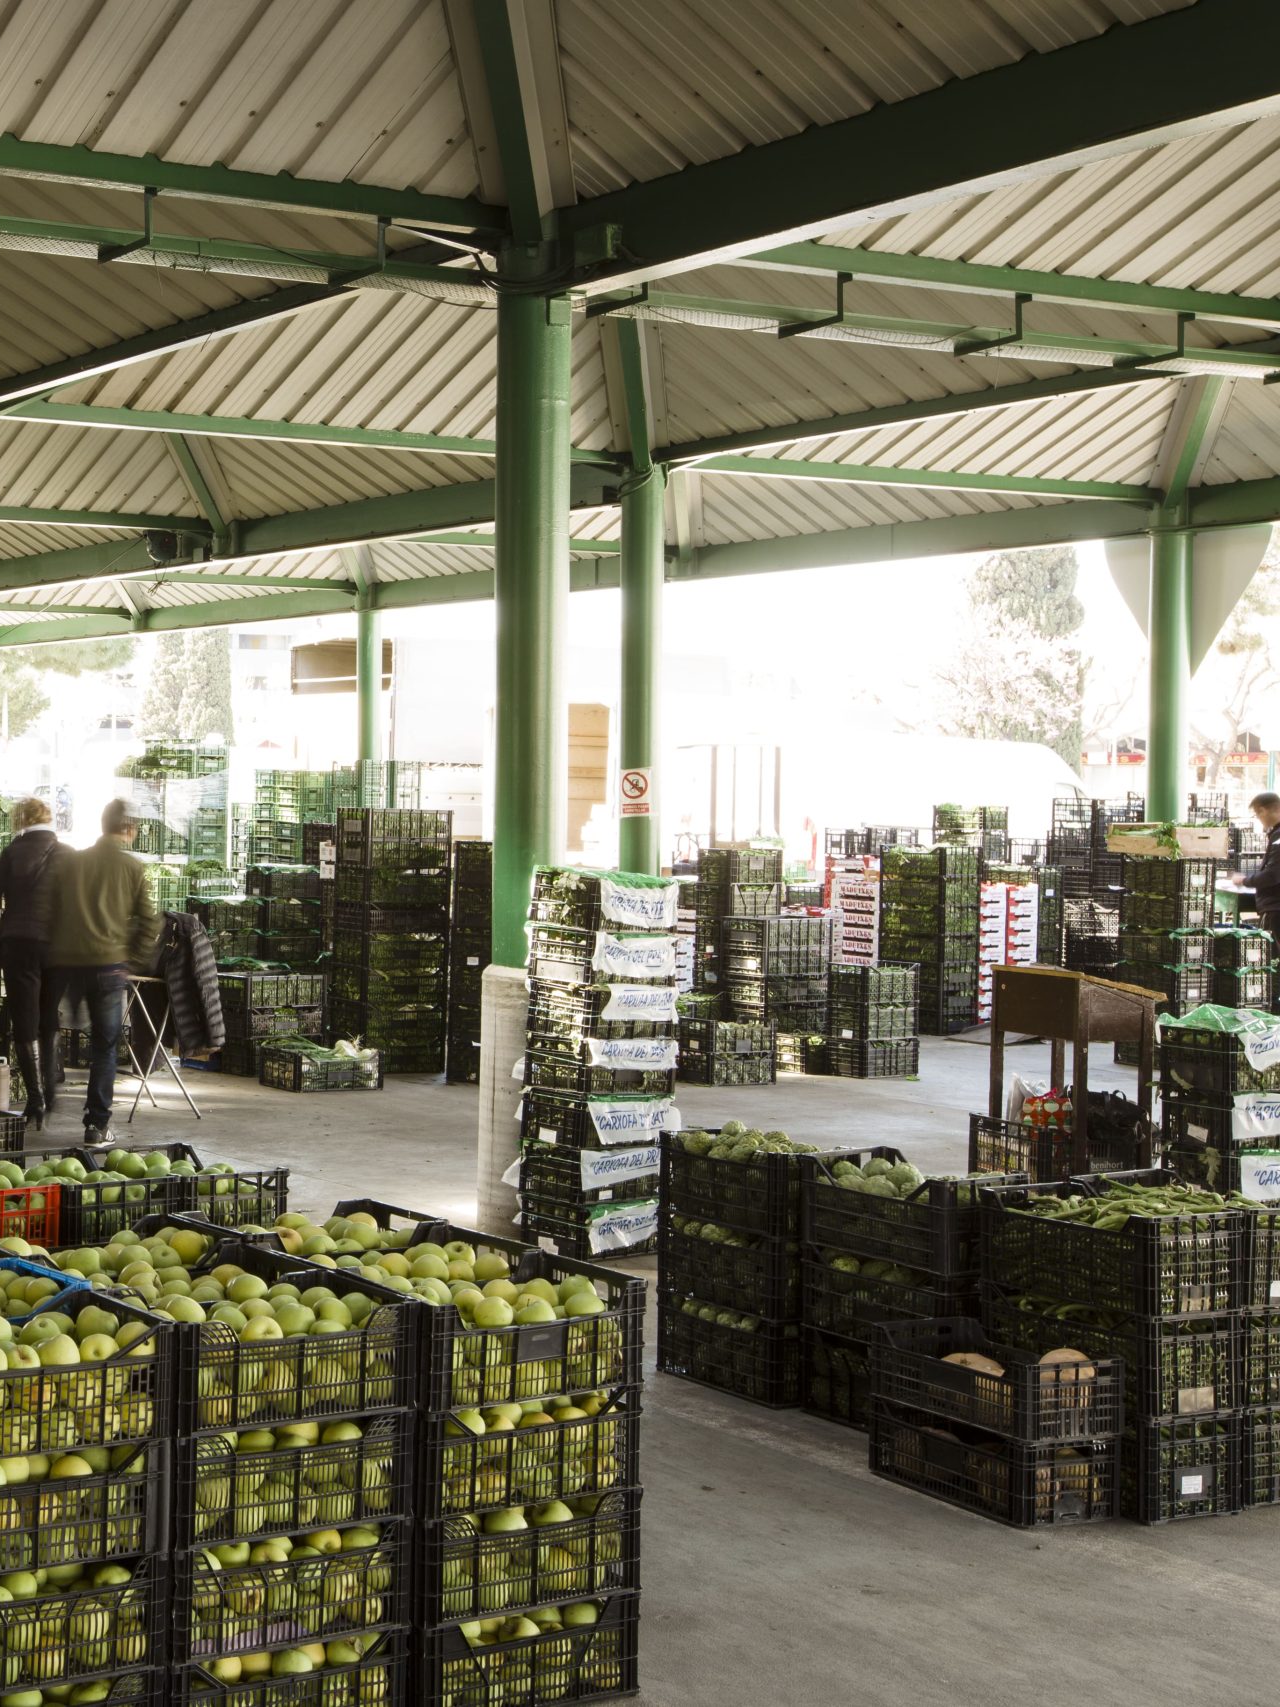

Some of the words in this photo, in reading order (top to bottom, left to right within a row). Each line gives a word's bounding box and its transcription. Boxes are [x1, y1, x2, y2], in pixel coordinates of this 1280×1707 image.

[840, 886, 874, 896] MADUIXES
[839, 900, 873, 910] MADUIXES
[843, 913, 873, 923] ADUIXES
[843, 928, 872, 938] ADUIXES
[842, 941, 872, 950] ADUIXES
[843, 955, 871, 966] ADUIXES
[629, 1152, 645, 1169] DEL
[1090, 1160, 1123, 1169] benihort
